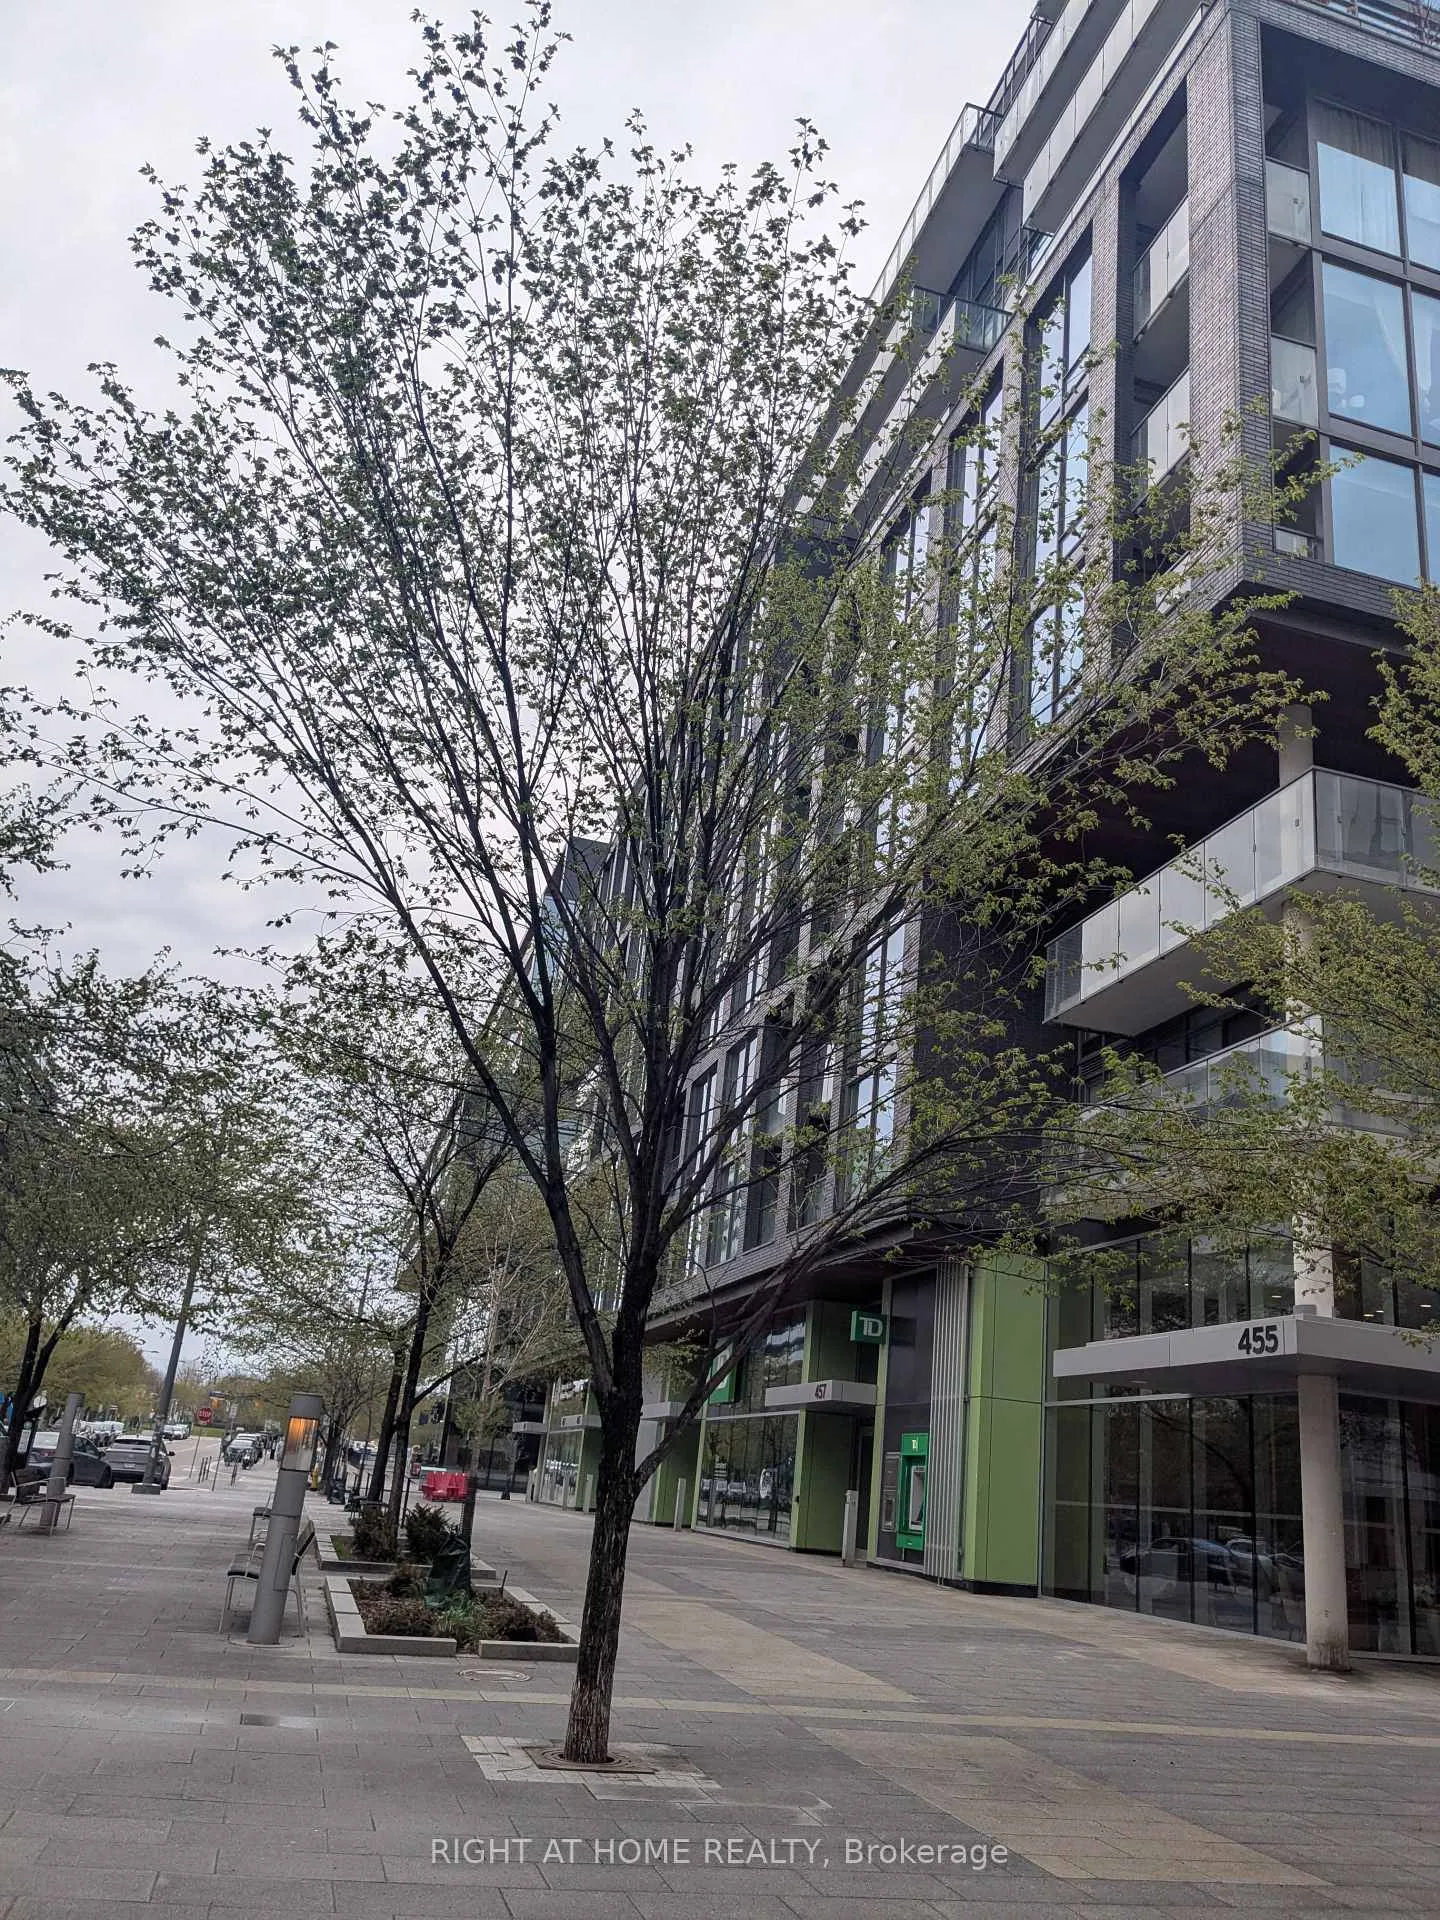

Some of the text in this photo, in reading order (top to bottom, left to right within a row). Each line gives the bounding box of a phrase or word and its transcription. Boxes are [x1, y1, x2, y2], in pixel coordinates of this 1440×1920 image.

[859, 1316, 884, 1337] TD
[1237, 1324, 1279, 1355] 455
[814, 1383, 827, 1400] 457
